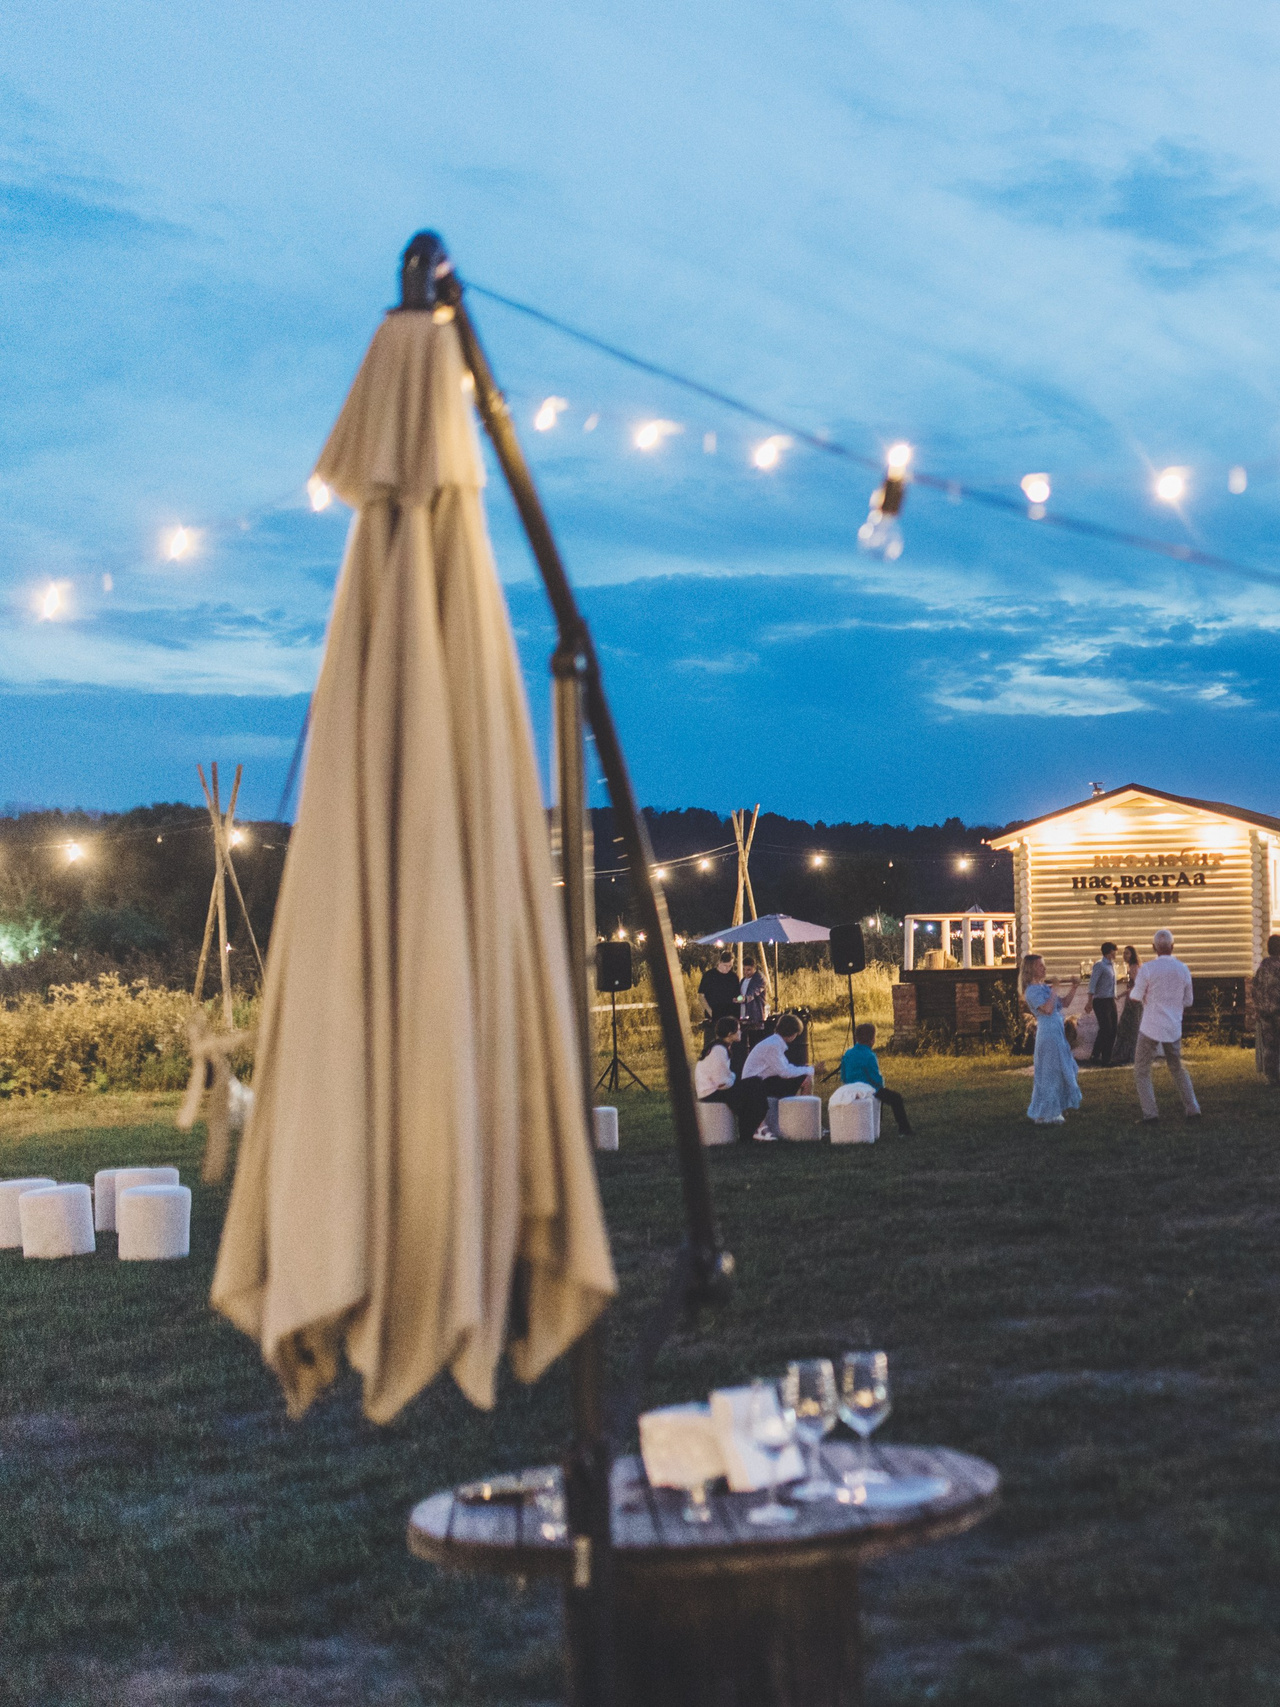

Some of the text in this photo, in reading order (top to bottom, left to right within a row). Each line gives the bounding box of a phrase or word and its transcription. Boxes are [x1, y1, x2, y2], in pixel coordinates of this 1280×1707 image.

[1120, 872, 1206, 888] всегда
[1095, 891, 1180, 905] с нами
